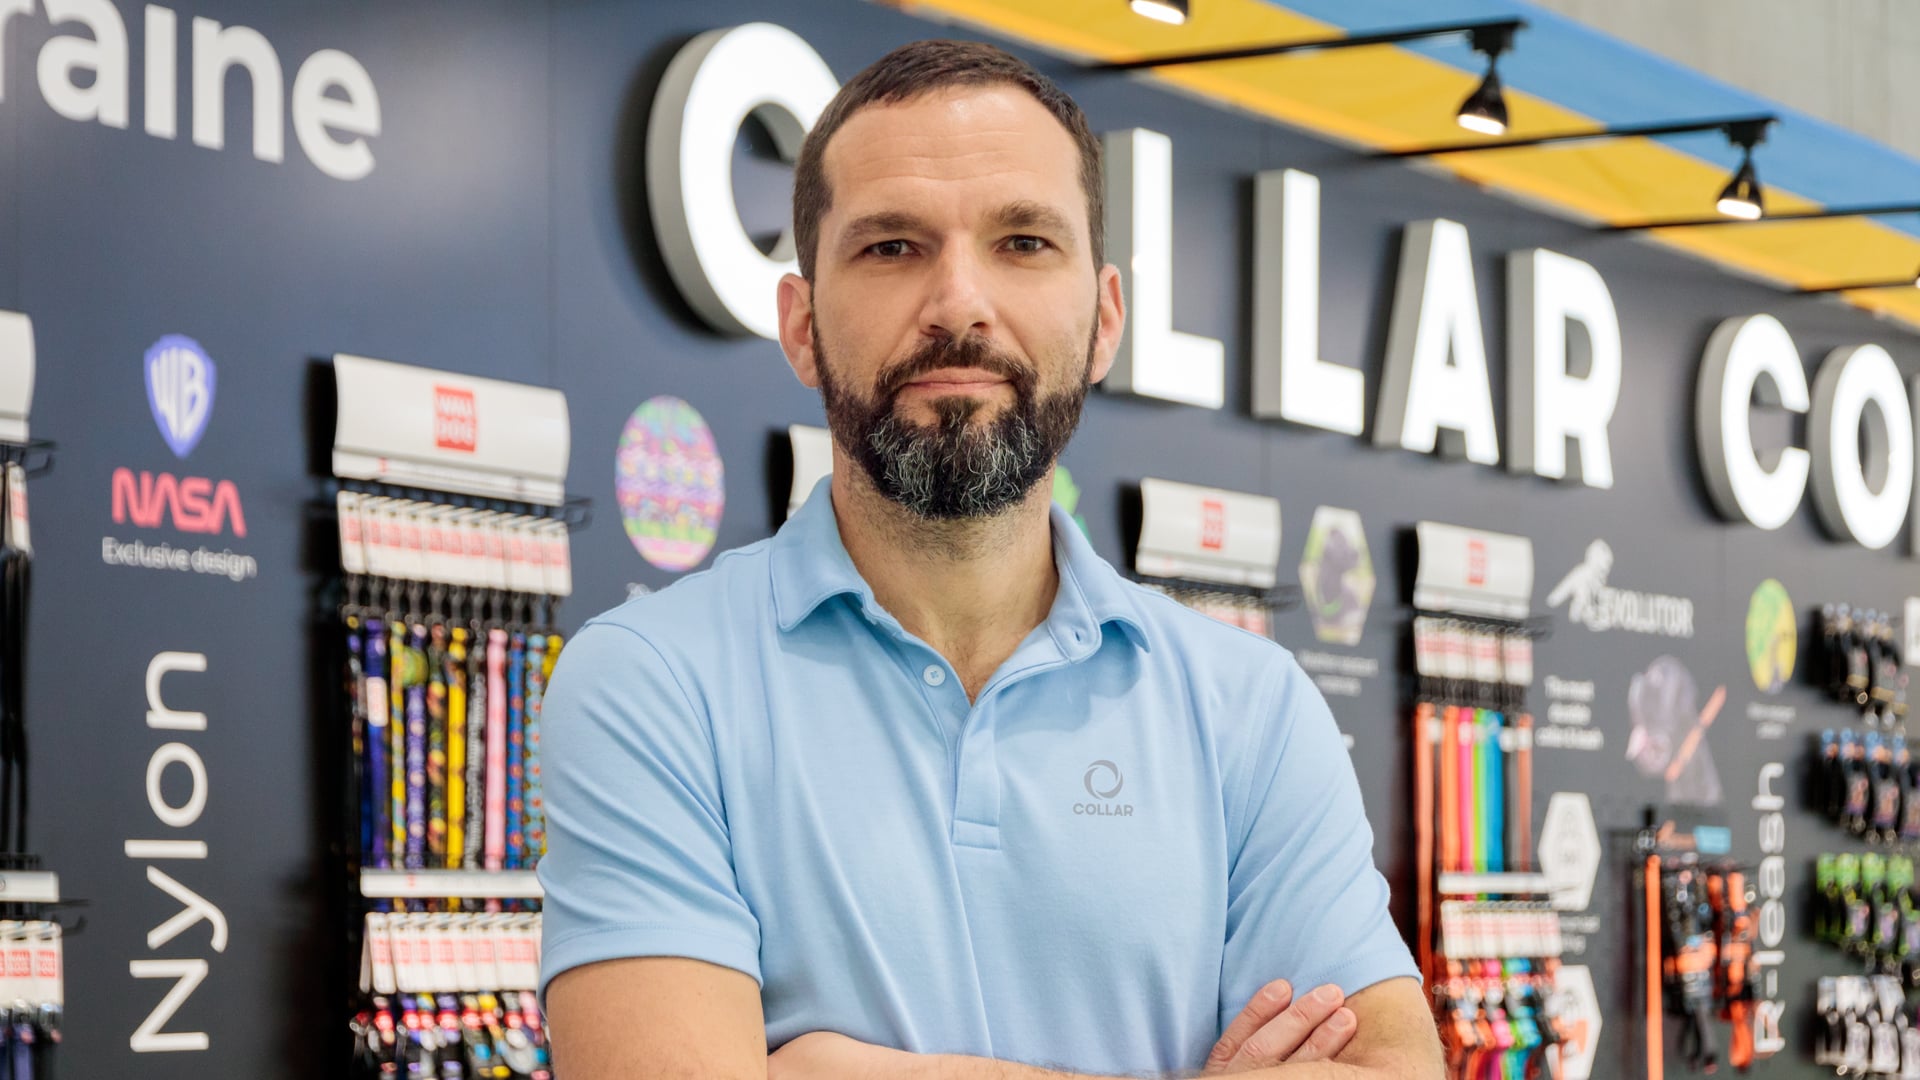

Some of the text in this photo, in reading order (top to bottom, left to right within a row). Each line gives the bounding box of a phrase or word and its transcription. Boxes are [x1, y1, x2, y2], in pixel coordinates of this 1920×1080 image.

[648, 22, 1919, 549] CLLAR CO
[150, 346, 209, 442] WB
[111, 466, 248, 539] NASA
[101, 536, 258, 582] Exclusive design
[124, 650, 229, 1053] Nylon
[1073, 802, 1134, 817] COLLAR
